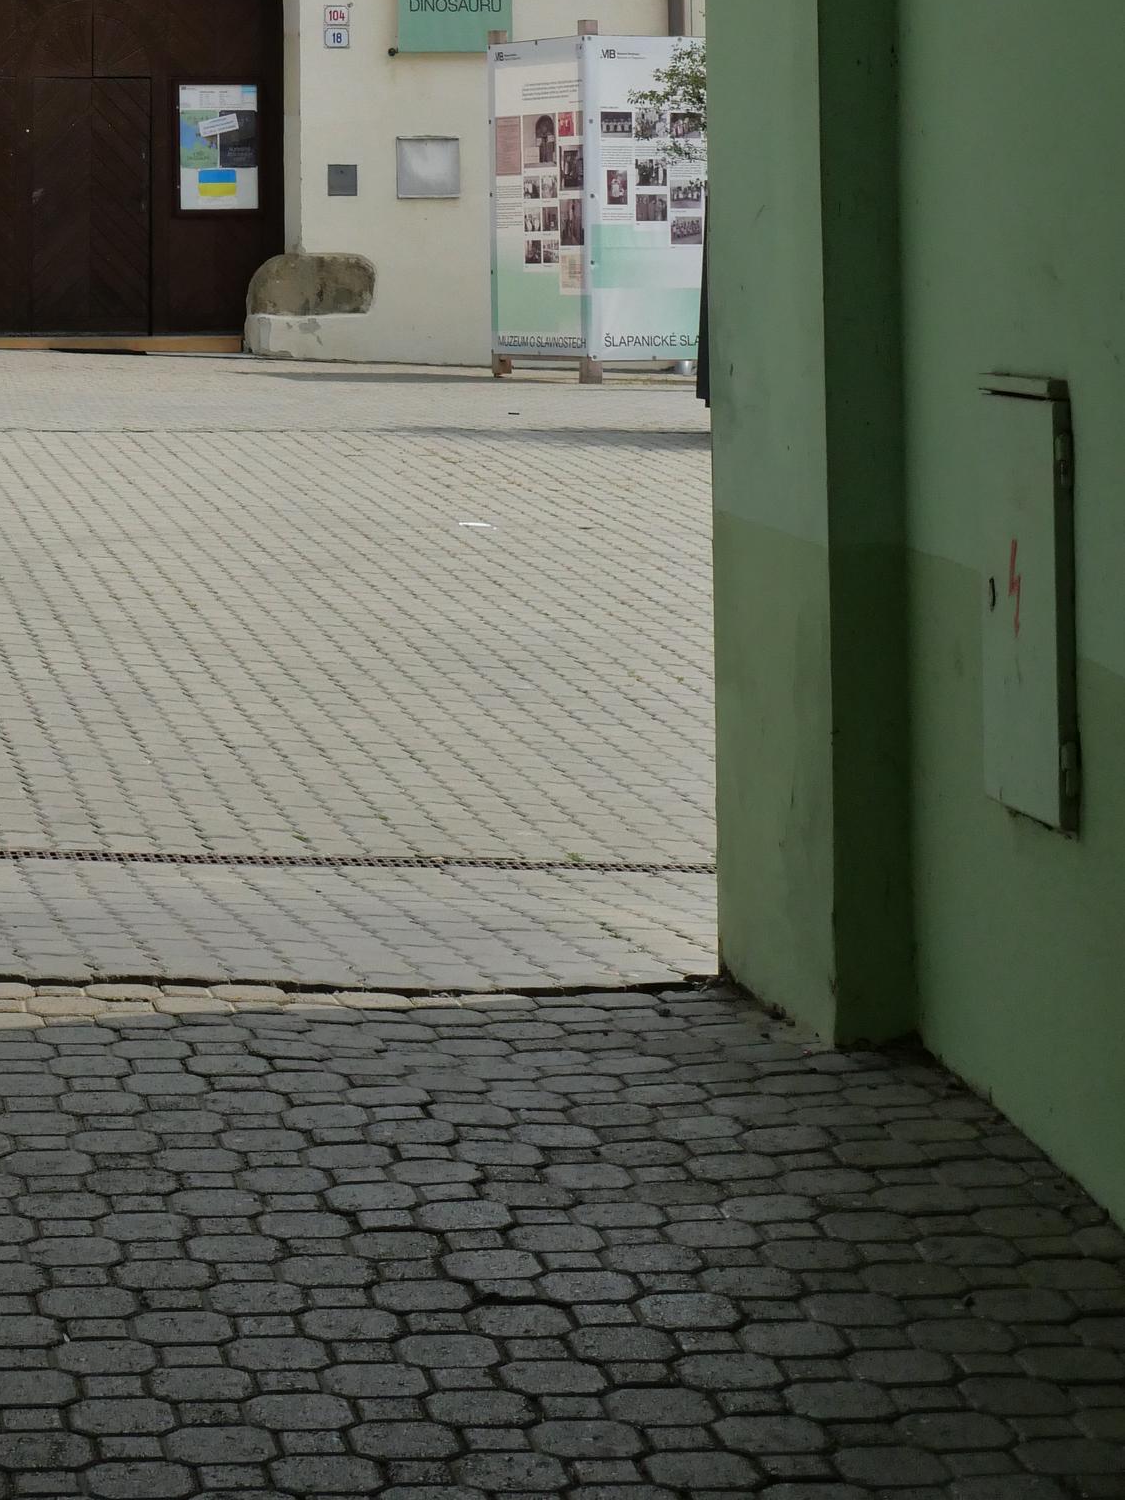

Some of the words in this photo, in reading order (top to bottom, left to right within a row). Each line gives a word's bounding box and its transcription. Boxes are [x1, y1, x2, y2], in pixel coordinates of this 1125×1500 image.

[328, 10, 345, 21] 104
[332, 32, 342, 44] 18
[497, 335, 529, 347] MUZEUM
[529, 336, 535, 348] O
[535, 336, 586, 349] SLAVNOSTECH
[604, 332, 677, 348] ŠLAPANICKÉ
